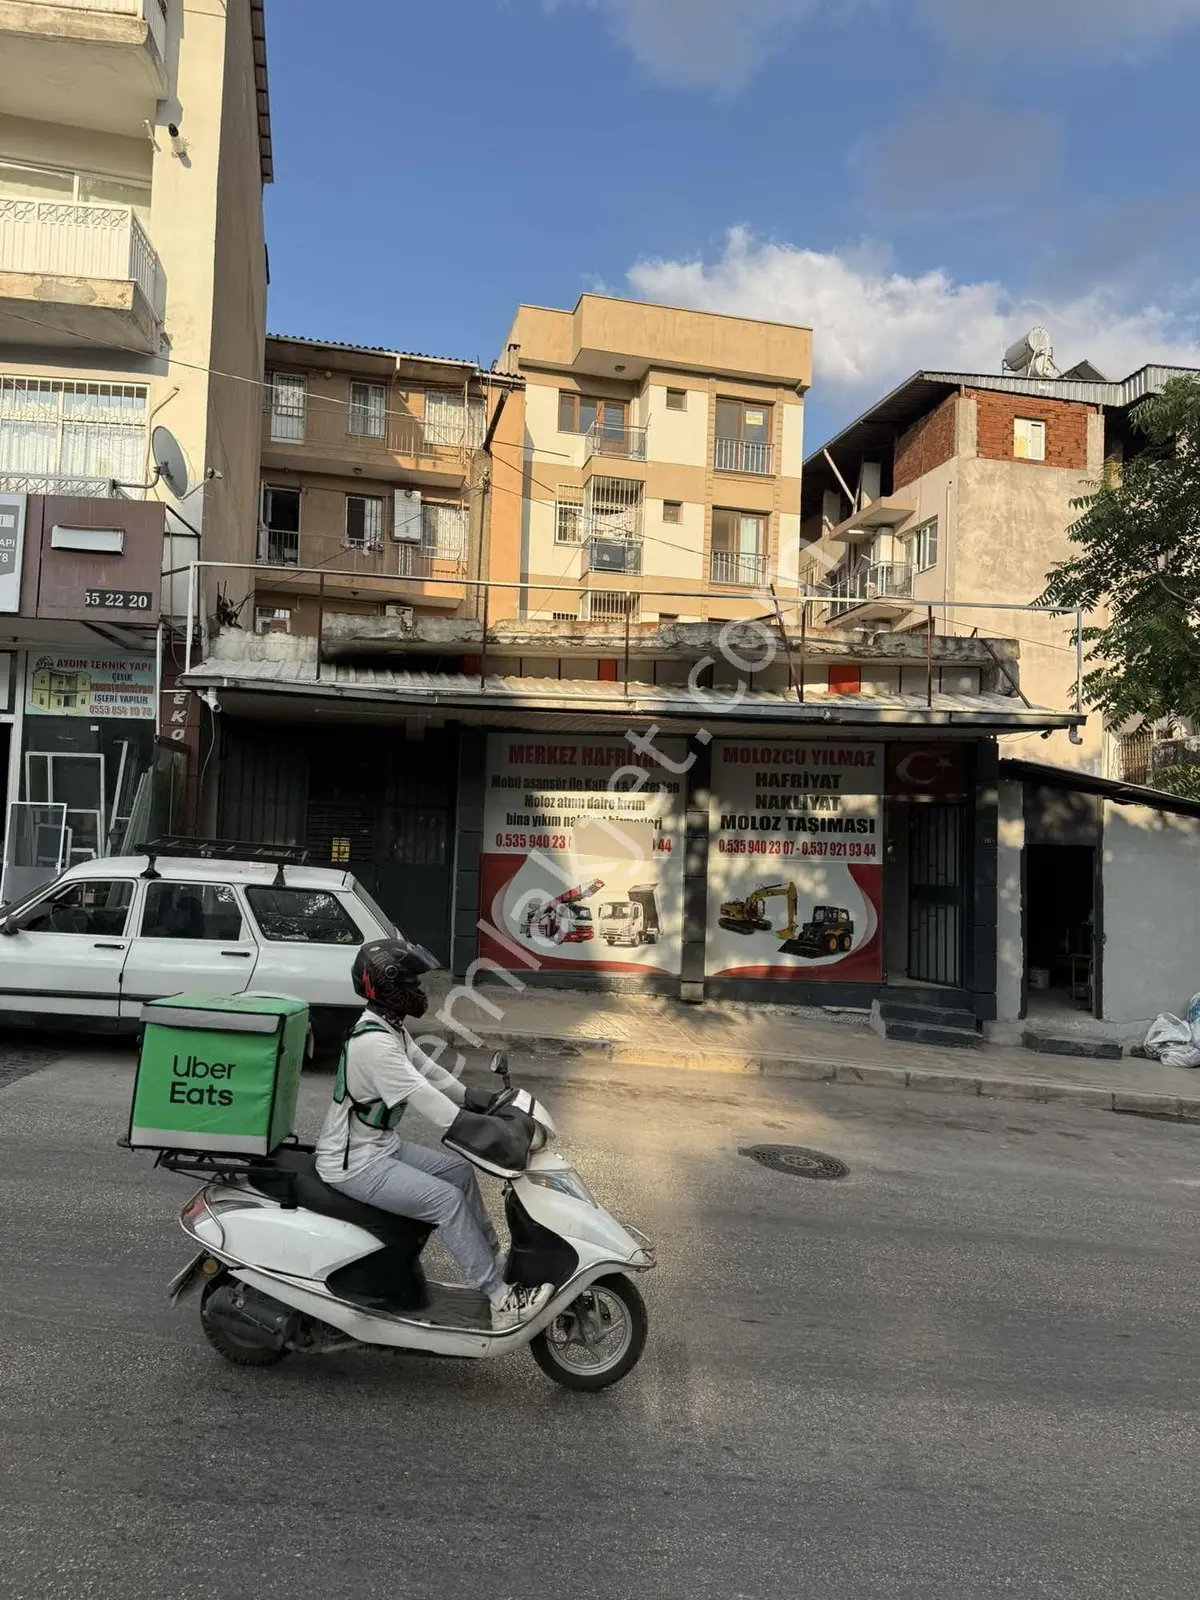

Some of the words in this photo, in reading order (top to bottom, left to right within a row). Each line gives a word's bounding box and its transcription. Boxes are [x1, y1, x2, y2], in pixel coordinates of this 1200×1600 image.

[105, 593, 124, 606] 22
[129, 595, 148, 608] 20
[57, 659, 87, 668] AYDIN
[508, 744, 577, 765] MERKEZ
[723, 746, 806, 765] MOLOZCU
[812, 750, 876, 767] YILMAZ
[491, 775, 521, 789] Mobil
[523, 775, 567, 790] asansör
[568, 776, 582, 790] ile
[755, 771, 842, 789] HAFRİYAT
[524, 795, 556, 808] Moloz
[587, 797, 615, 811] daire
[617, 798, 646, 811] kırım
[755, 793, 841, 811] NAKLİYAT
[506, 812, 530, 826] bina
[532, 813, 561, 829] yıkım
[720, 815, 781, 830] MOLOZ
[785, 816, 876, 835] TAŞIMASI
[496, 832, 527, 849] 0.535
[529, 834, 550, 849] 940
[552, 835, 566, 849] 23
[657, 838, 672, 852] 44
[719, 839, 745, 853] 0.535
[748, 840, 766, 854] 940
[769, 841, 781, 854] 23
[783, 841, 795, 855] 07
[801, 841, 827, 856] 0.537
[830, 842, 847, 856] 921
[849, 842, 861, 856] 93
[863, 843, 876, 857] 44
[172, 1055, 236, 1080] Uber
[169, 1081, 234, 1107] Eats
